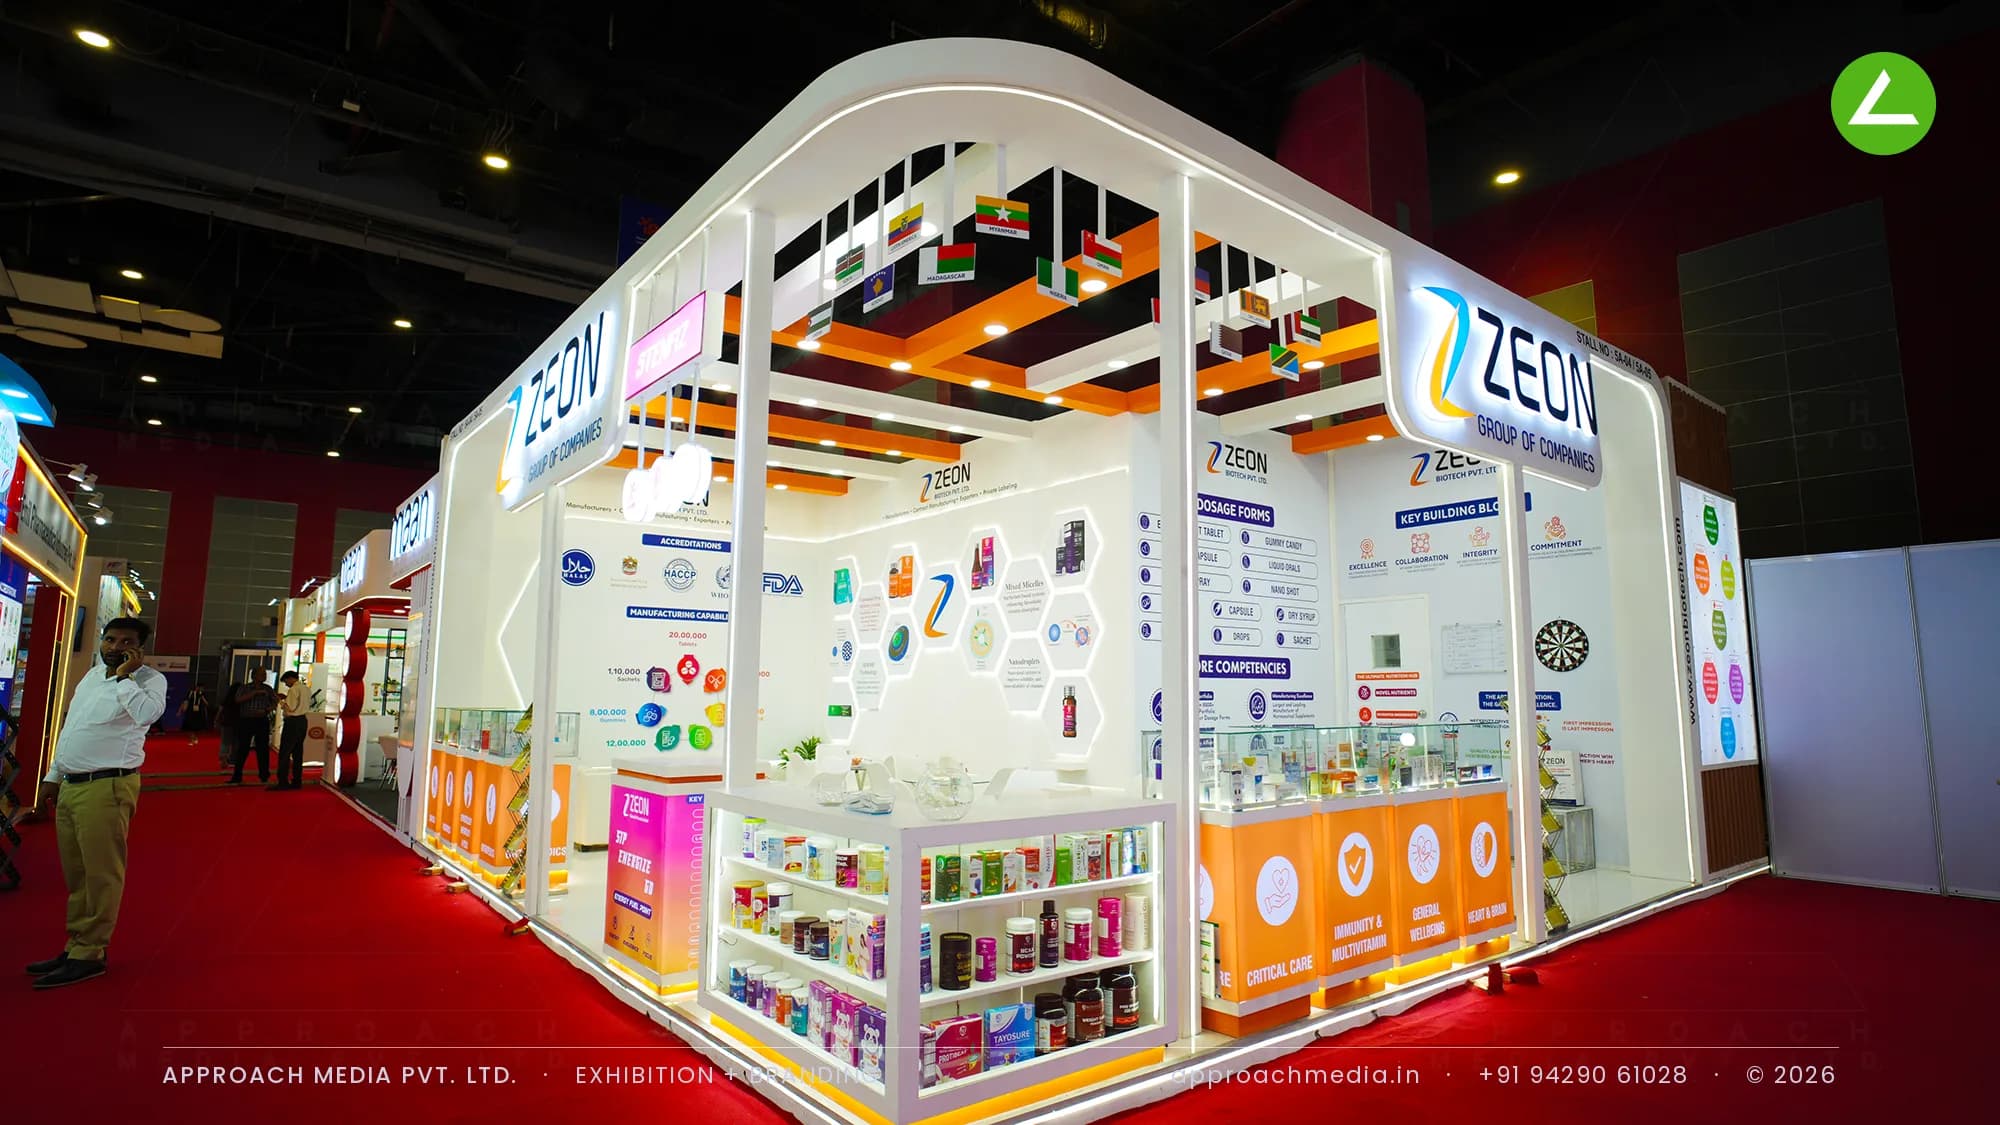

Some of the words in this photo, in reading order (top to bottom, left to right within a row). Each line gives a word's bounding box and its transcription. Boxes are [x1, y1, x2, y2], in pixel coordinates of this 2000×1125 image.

[989, 226, 1018, 235] MYANMAR
[927, 272, 966, 282] MADAGASCAR
[1576, 331, 1599, 351] STALL
[1599, 343, 1610, 357] NO
[525, 311, 605, 447] ZEON
[1476, 307, 1598, 436] ZEON
[529, 459, 548, 483] GROUP
[549, 448, 559, 469] OF
[560, 417, 603, 462] COMPANIES
[1478, 414, 1518, 447] GROUP
[1522, 430, 1536, 453] OF
[1540, 436, 1595, 473] COMPANIES
[1225, 444, 1268, 475] ZEON
[1435, 450, 1481, 471] ZE
[934, 462, 971, 490] ZEON
[1225, 469, 1247, 481] BIOTECH
[1435, 470, 1467, 482] BIOTECH
[1467, 468, 1485, 479] PVT.
[566, 501, 612, 513] Manufacturers
[1198, 498, 1237, 516] DOSAGE
[1238, 506, 1271, 523] FORMS
[1400, 511, 1422, 525] KEY
[1423, 504, 1476, 521] BUILDING
[1479, 501, 1500, 515] BLO
[1203, 527, 1224, 539] TABLET
[660, 537, 722, 550] ACCREDITATIONS
[1264, 536, 1284, 548] GUMMY
[1285, 538, 1303, 550] CANDY
[1530, 539, 1583, 551] COMMITMENT
[1198, 552, 1218, 563] PSULE
[1395, 554, 1449, 567] COLLABORATION
[1462, 548, 1498, 559] INTEGRITY
[1268, 561, 1286, 572] LIQUID
[1286, 563, 1301, 573] ORALS
[1349, 560, 1388, 571] EXCELLENCE
[663, 569, 697, 579] HACCP
[762, 572, 804, 595] FDA
[1022, 579, 1044, 589] Micelles
[1270, 585, 1286, 595] NANO
[1286, 586, 1300, 597] SHOT
[630, 608, 696, 619] MANUFACTURING
[696, 611, 729, 621] CAPABILI
[1228, 605, 1254, 617] CAPSULE
[1299, 612, 1316, 622] SYRUP
[1674, 516, 1696, 726] www.zeonbiotech.com
[1232, 632, 1250, 642] DROPS
[1293, 635, 1312, 645] SACHET
[1198, 660, 1213, 673] RE
[1215, 660, 1287, 675] COMPETENCIES
[1545, 757, 1566, 765] ZEON
[629, 794, 650, 817] ZEON
[1412, 902, 1441, 921] GENERAL
[1467, 908, 1485, 924] HEART
[1491, 902, 1507, 917] BRAIN
[1334, 917, 1374, 941] IMMUNITY
[1375, 914, 1383, 929] &
[1409, 921, 1446, 943] WELLBEING
[1331, 934, 1387, 963] MULTIVITAMIN
[1247, 962, 1288, 987] CRITICAL
[1289, 954, 1313, 975] CARE
